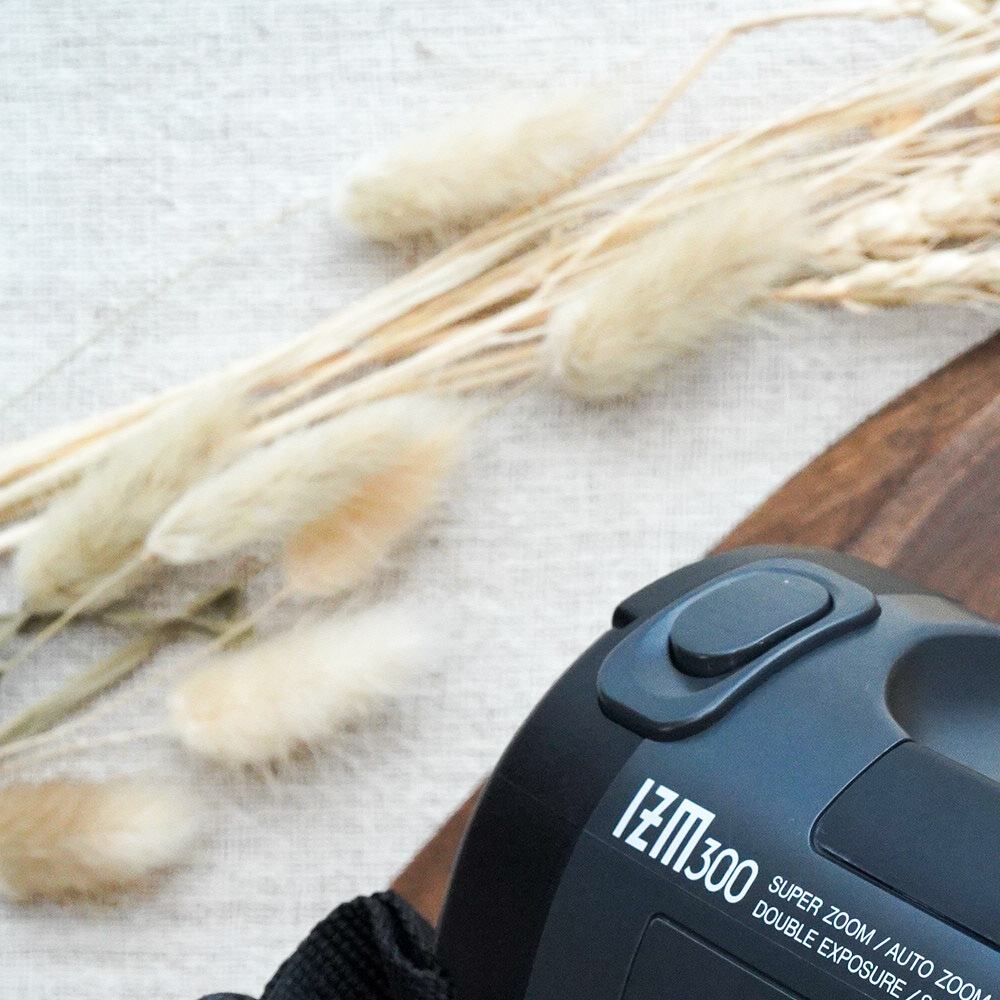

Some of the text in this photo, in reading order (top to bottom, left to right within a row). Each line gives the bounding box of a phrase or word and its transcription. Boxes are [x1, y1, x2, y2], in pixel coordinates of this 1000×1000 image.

[751, 899, 819, 949] DOUBLE
[816, 936, 908, 1000] EXPOSURE
[767, 874, 825, 918] SUPER
[820, 904, 878, 947] ZOOM
[884, 942, 935, 979] AUTO
